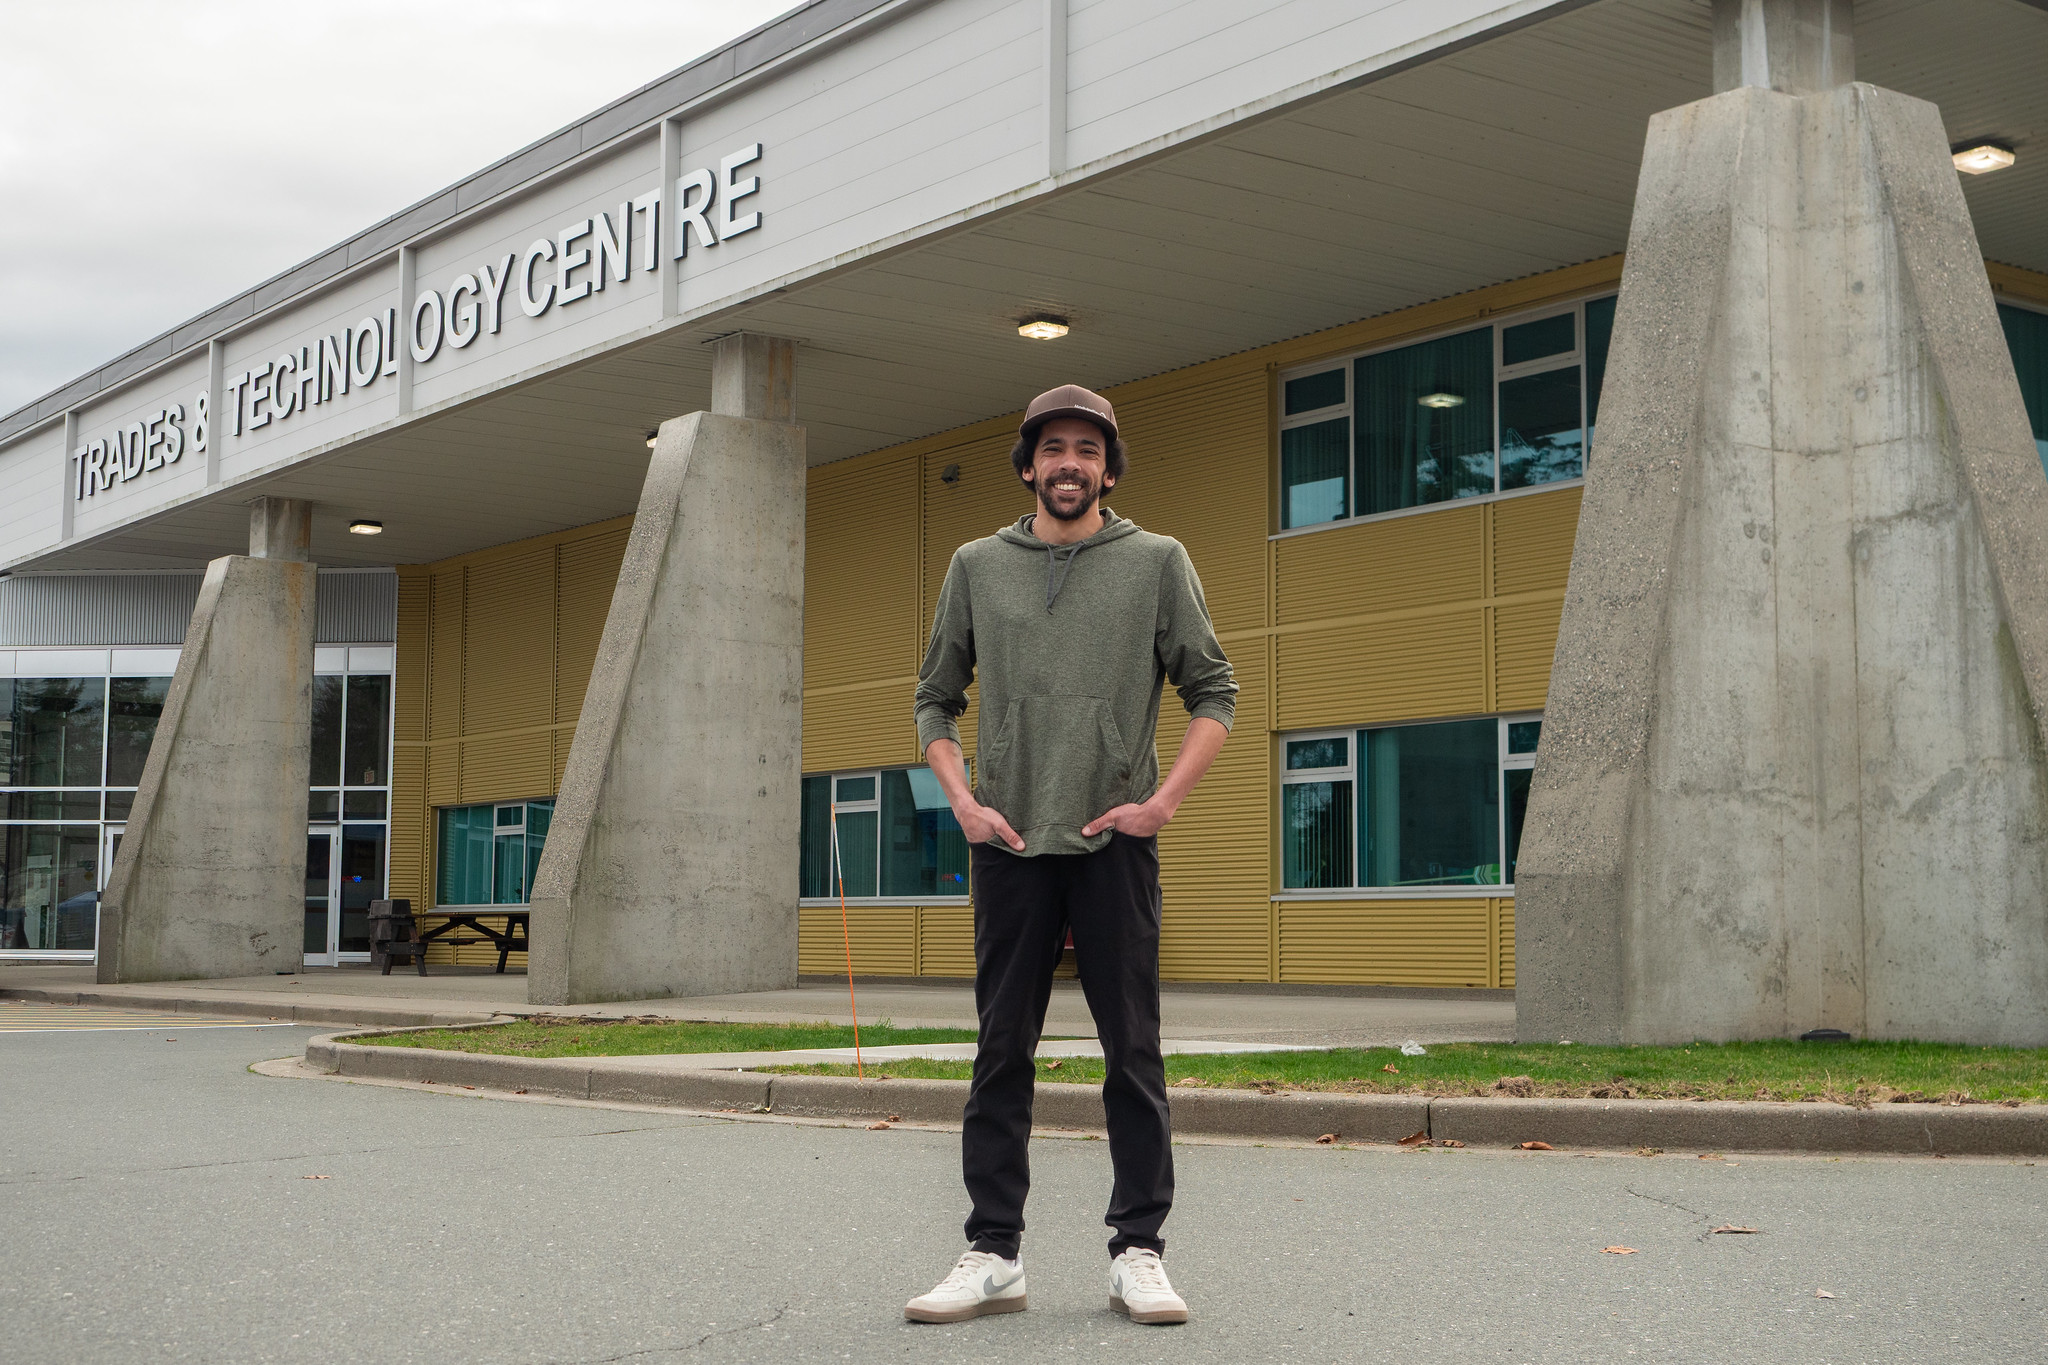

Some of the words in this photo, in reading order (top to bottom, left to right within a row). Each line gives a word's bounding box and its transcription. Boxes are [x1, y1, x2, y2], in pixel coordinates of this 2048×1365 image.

[72, 404, 185, 500] TRADES
[192, 390, 208, 452] &
[227, 253, 515, 437] TECHNOLOGY
[519, 143, 763, 318] CENTRE
